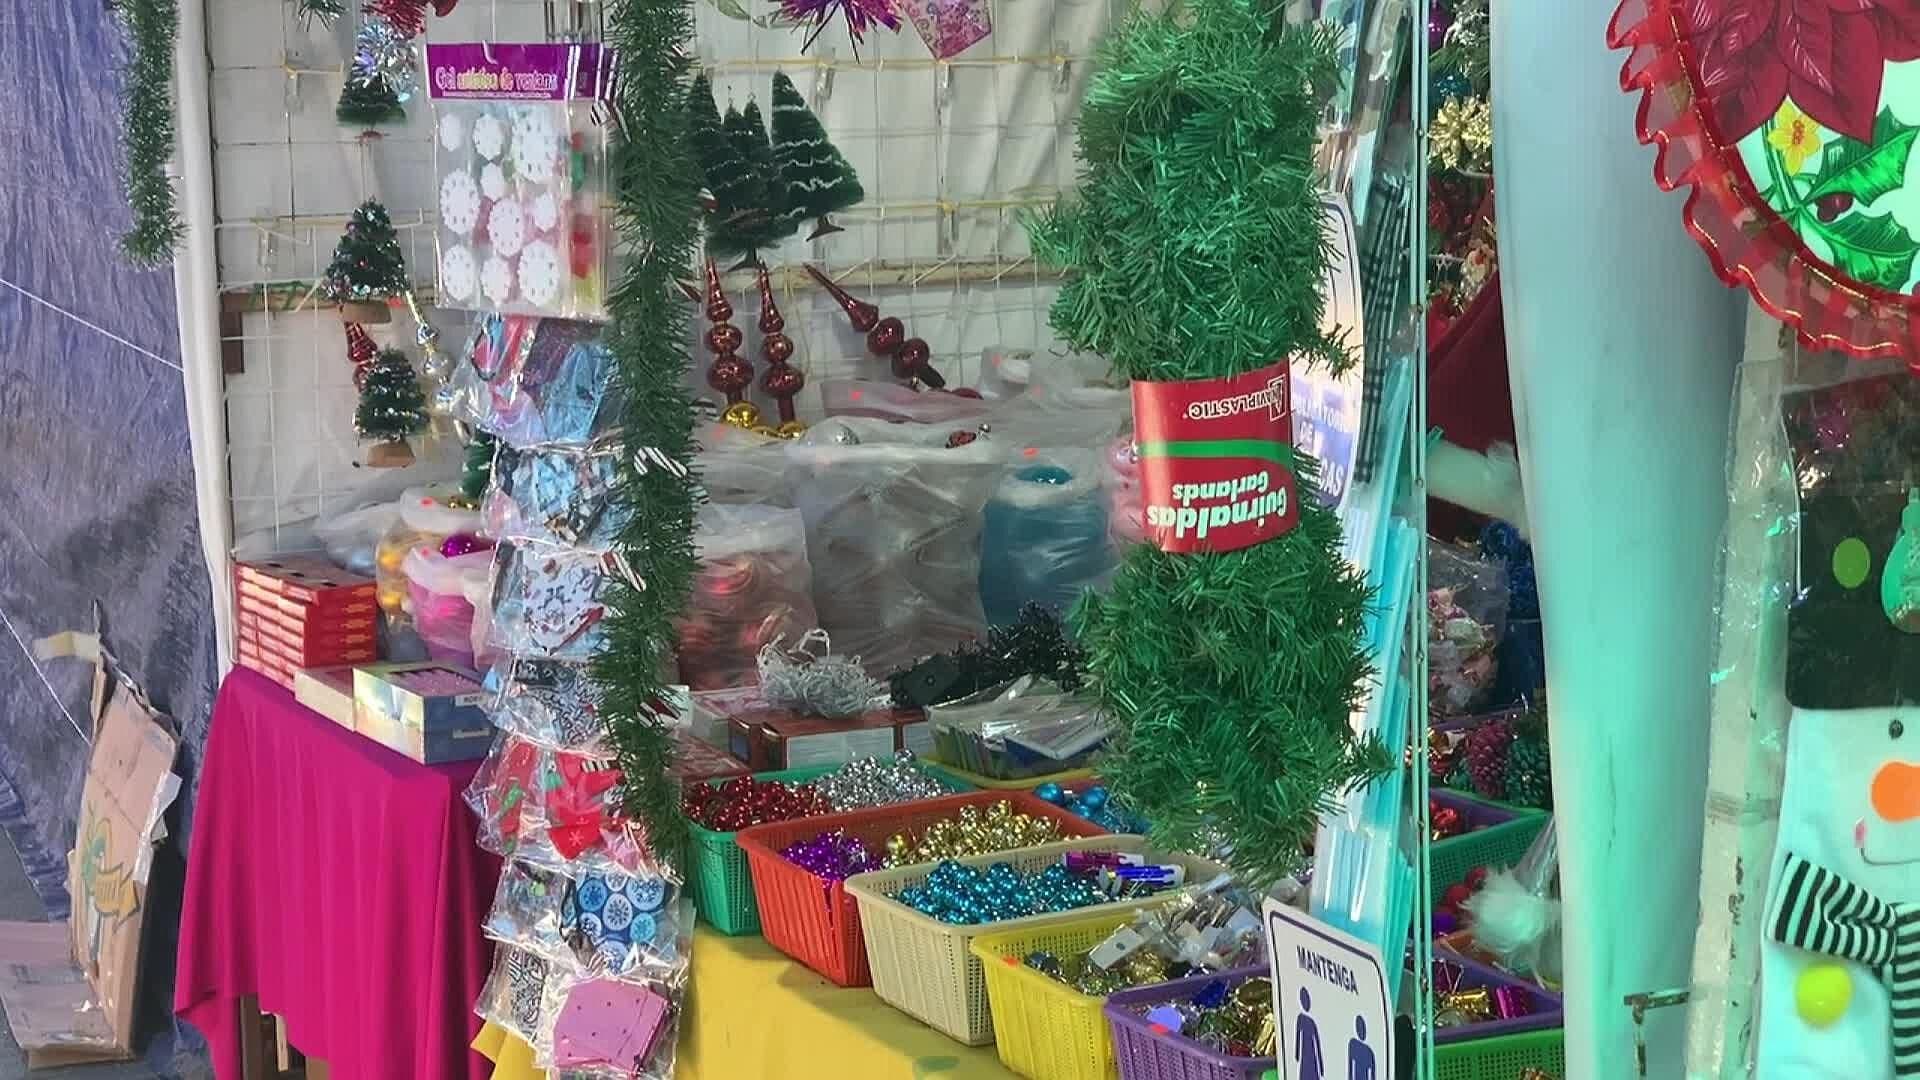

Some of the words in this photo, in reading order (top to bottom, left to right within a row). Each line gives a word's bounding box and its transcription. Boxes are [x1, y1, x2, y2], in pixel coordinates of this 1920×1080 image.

[1147, 486, 1287, 539] Guirnaldas
[1172, 470, 1269, 506] Garlands
[1296, 944, 1359, 995] MANTENGA
